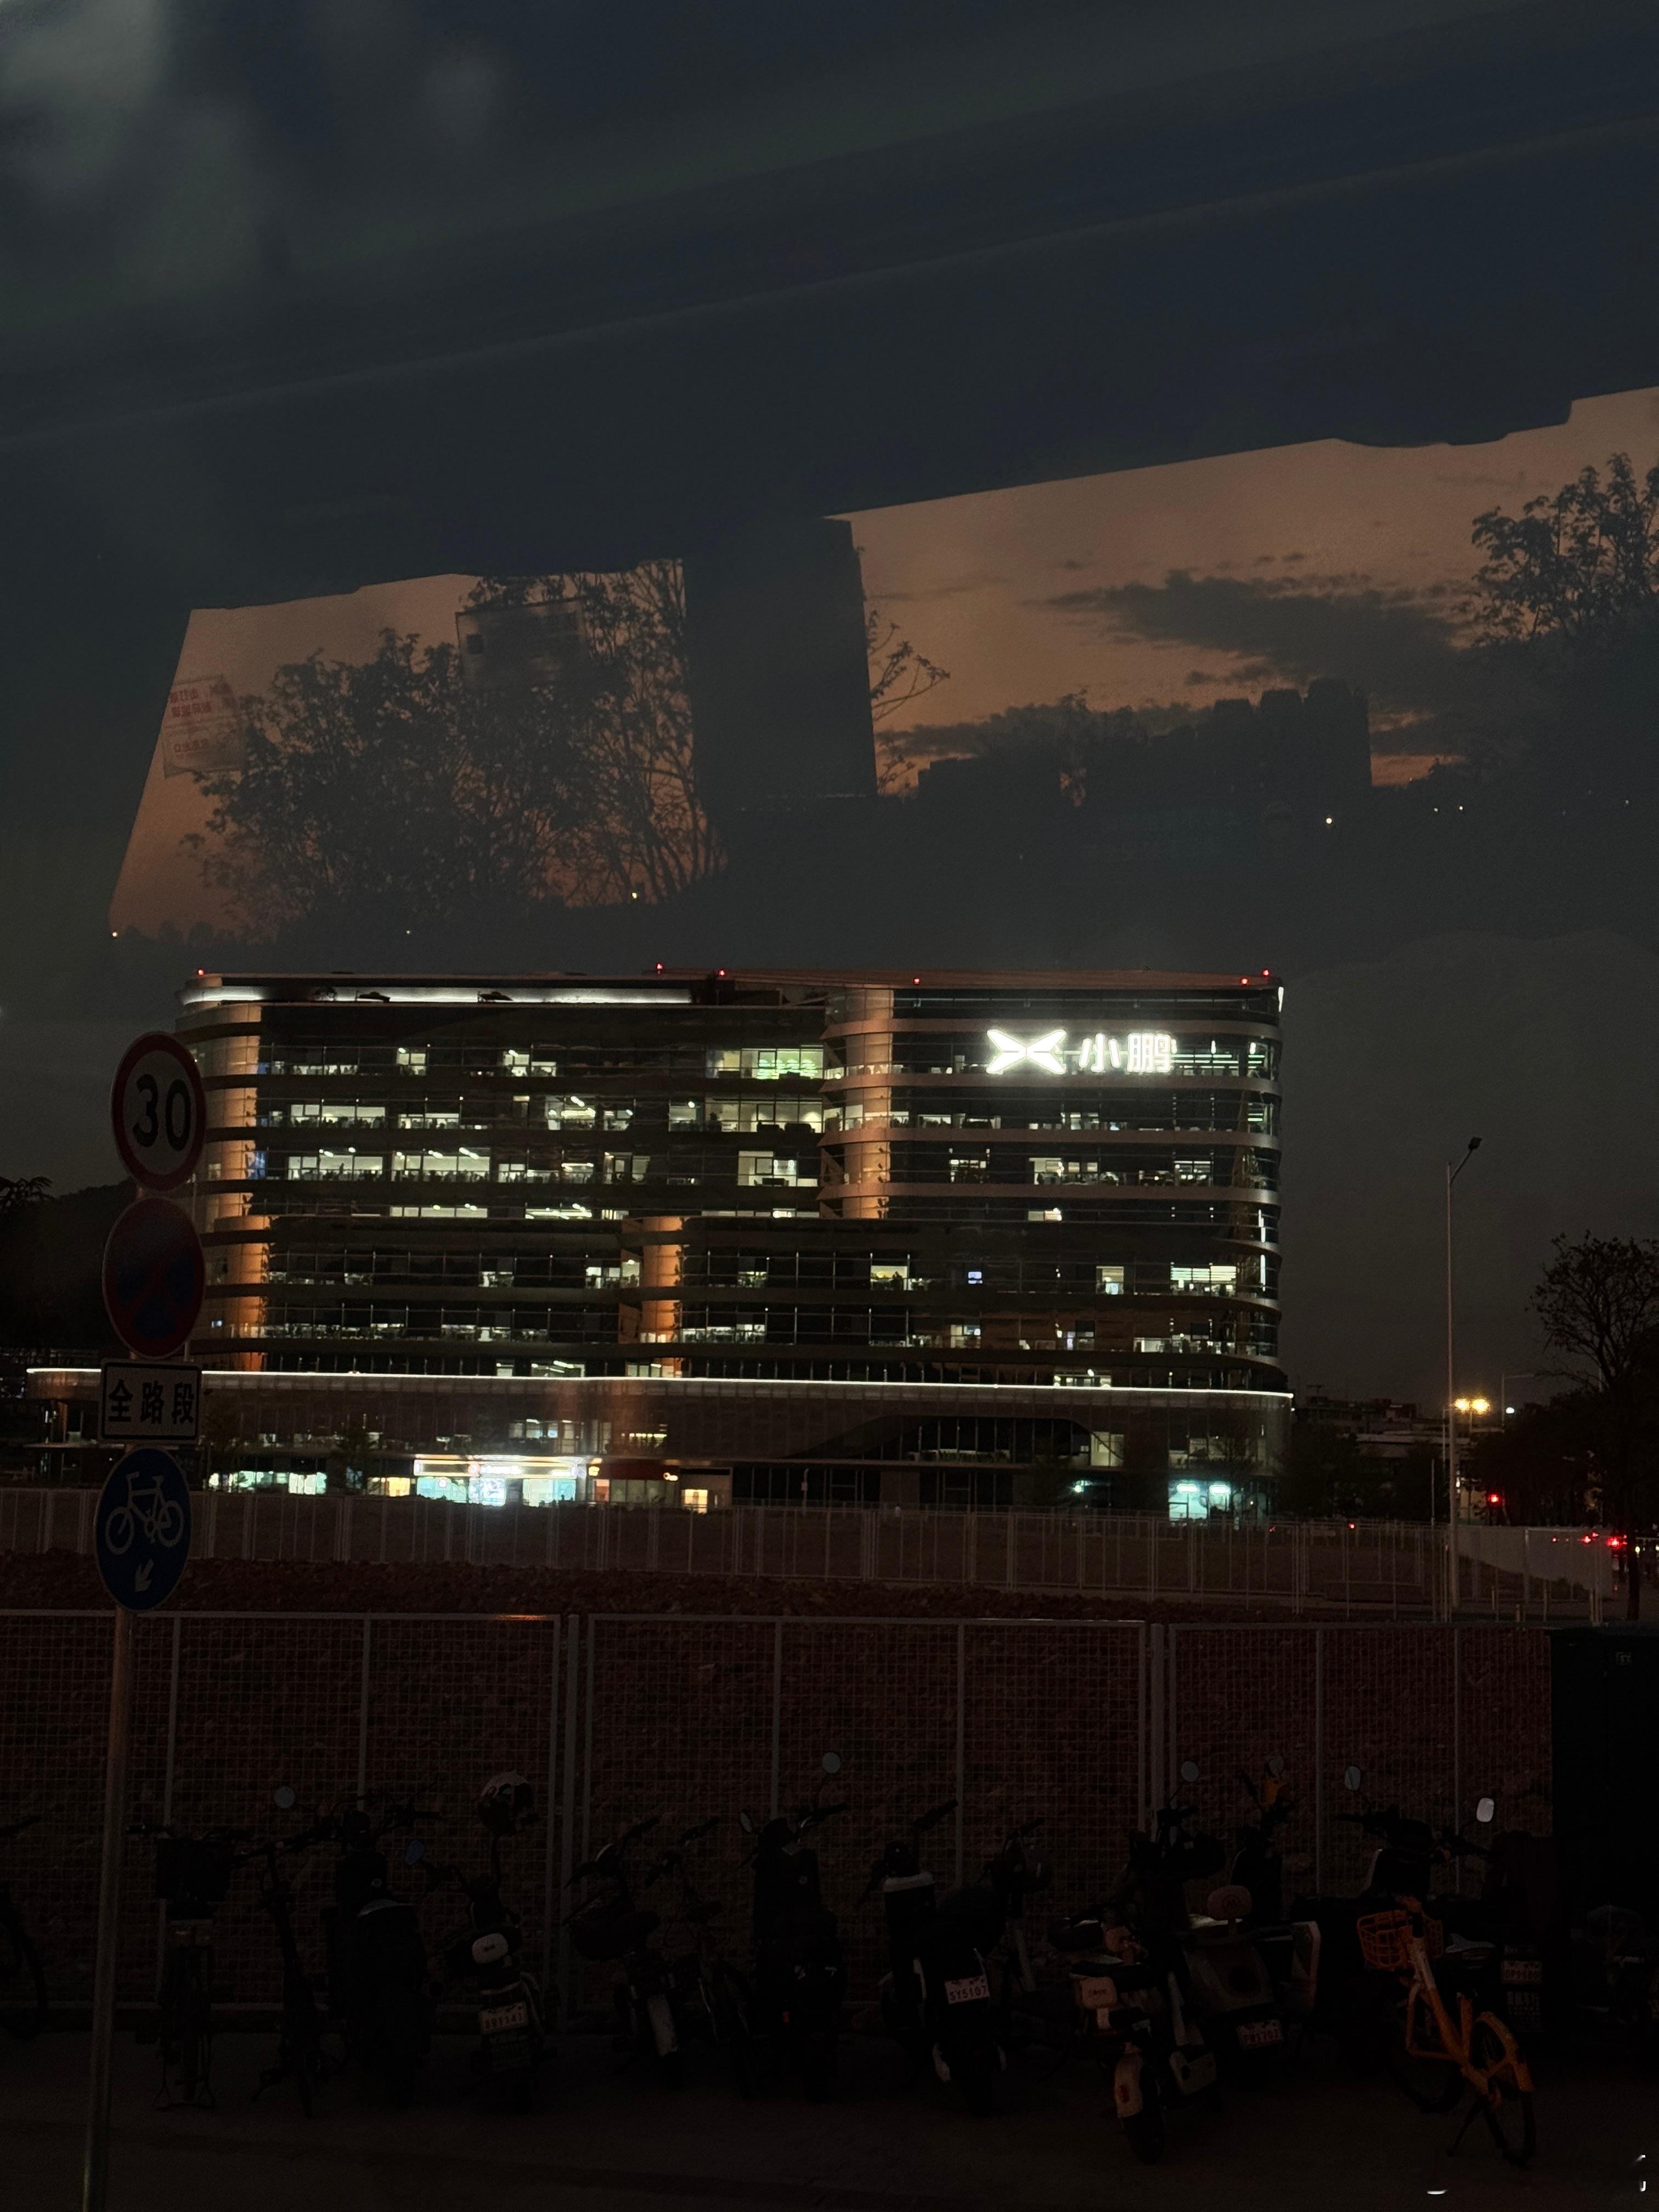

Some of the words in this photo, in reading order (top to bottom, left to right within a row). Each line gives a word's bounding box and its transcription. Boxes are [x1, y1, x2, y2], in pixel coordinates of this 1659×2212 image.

[1079, 1034, 1171, 1073] 小鹏
[133, 1074, 190, 1150] 30
[109, 1380, 194, 1424] 全路段
